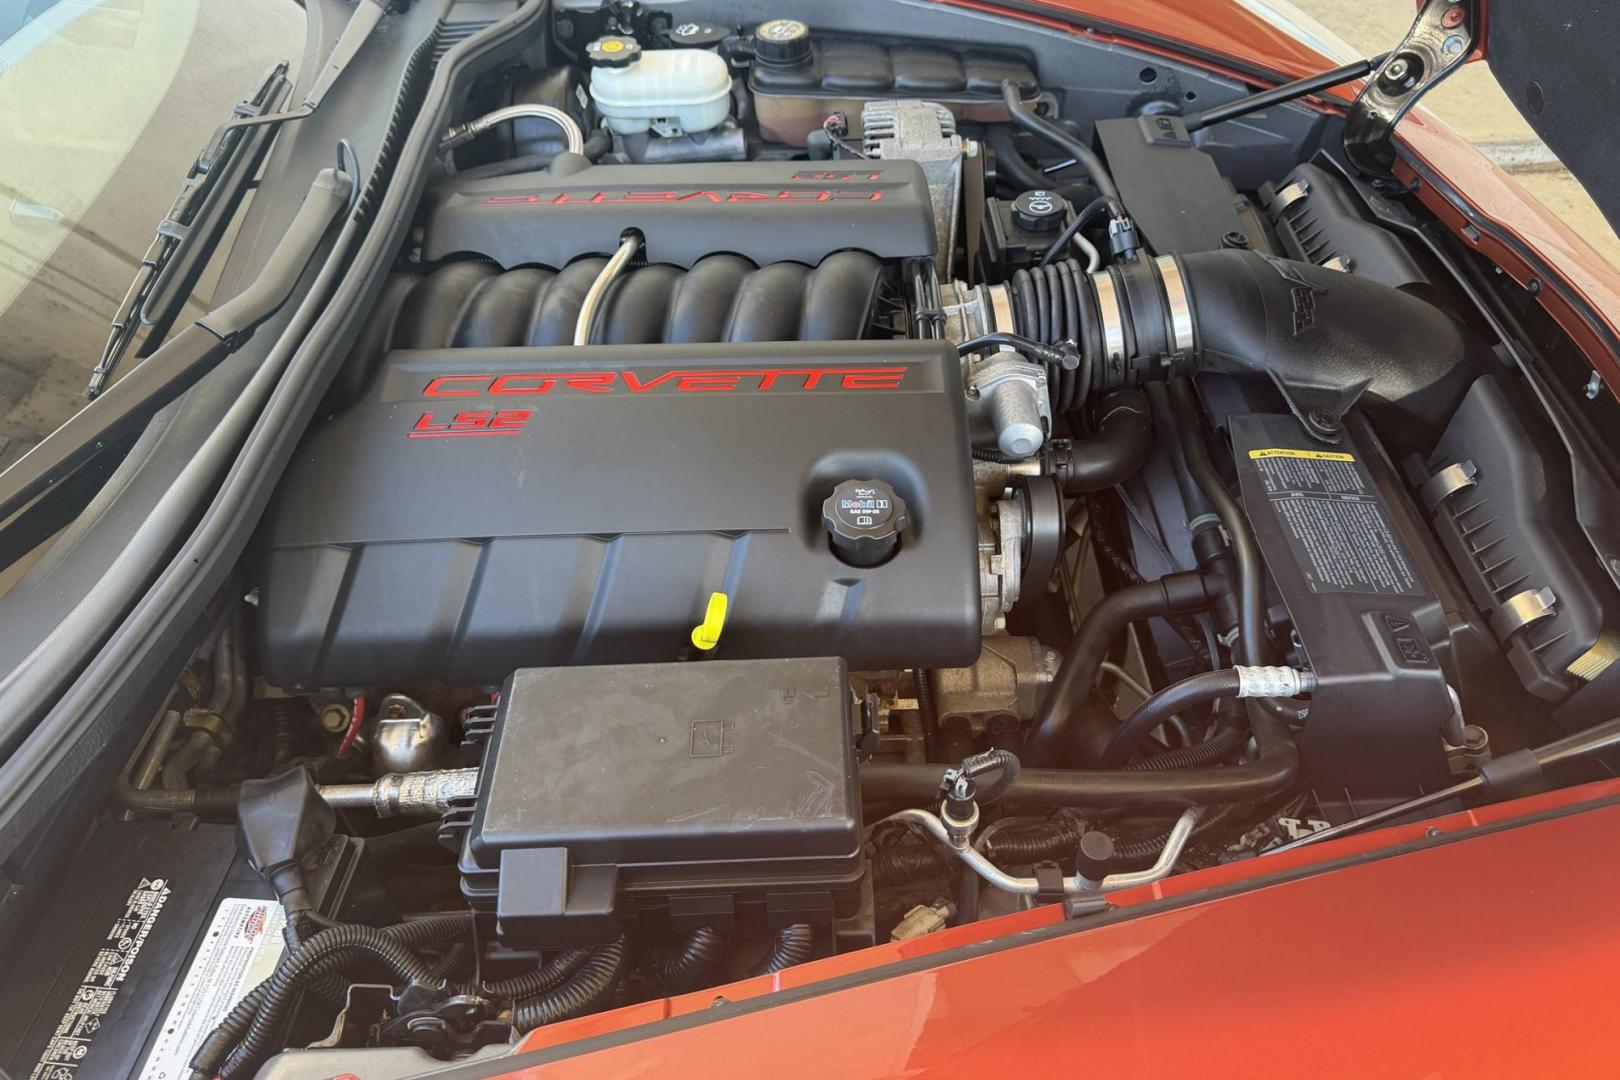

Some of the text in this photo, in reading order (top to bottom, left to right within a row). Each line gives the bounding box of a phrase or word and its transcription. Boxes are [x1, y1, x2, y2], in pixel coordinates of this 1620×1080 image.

[480, 190, 885, 207] CORVETTE
[423, 366, 908, 396] CORVETTE
[412, 409, 533, 432] LS2
[842, 500, 875, 508] Mobil
[116, 895, 168, 982] DANGER/POISON
